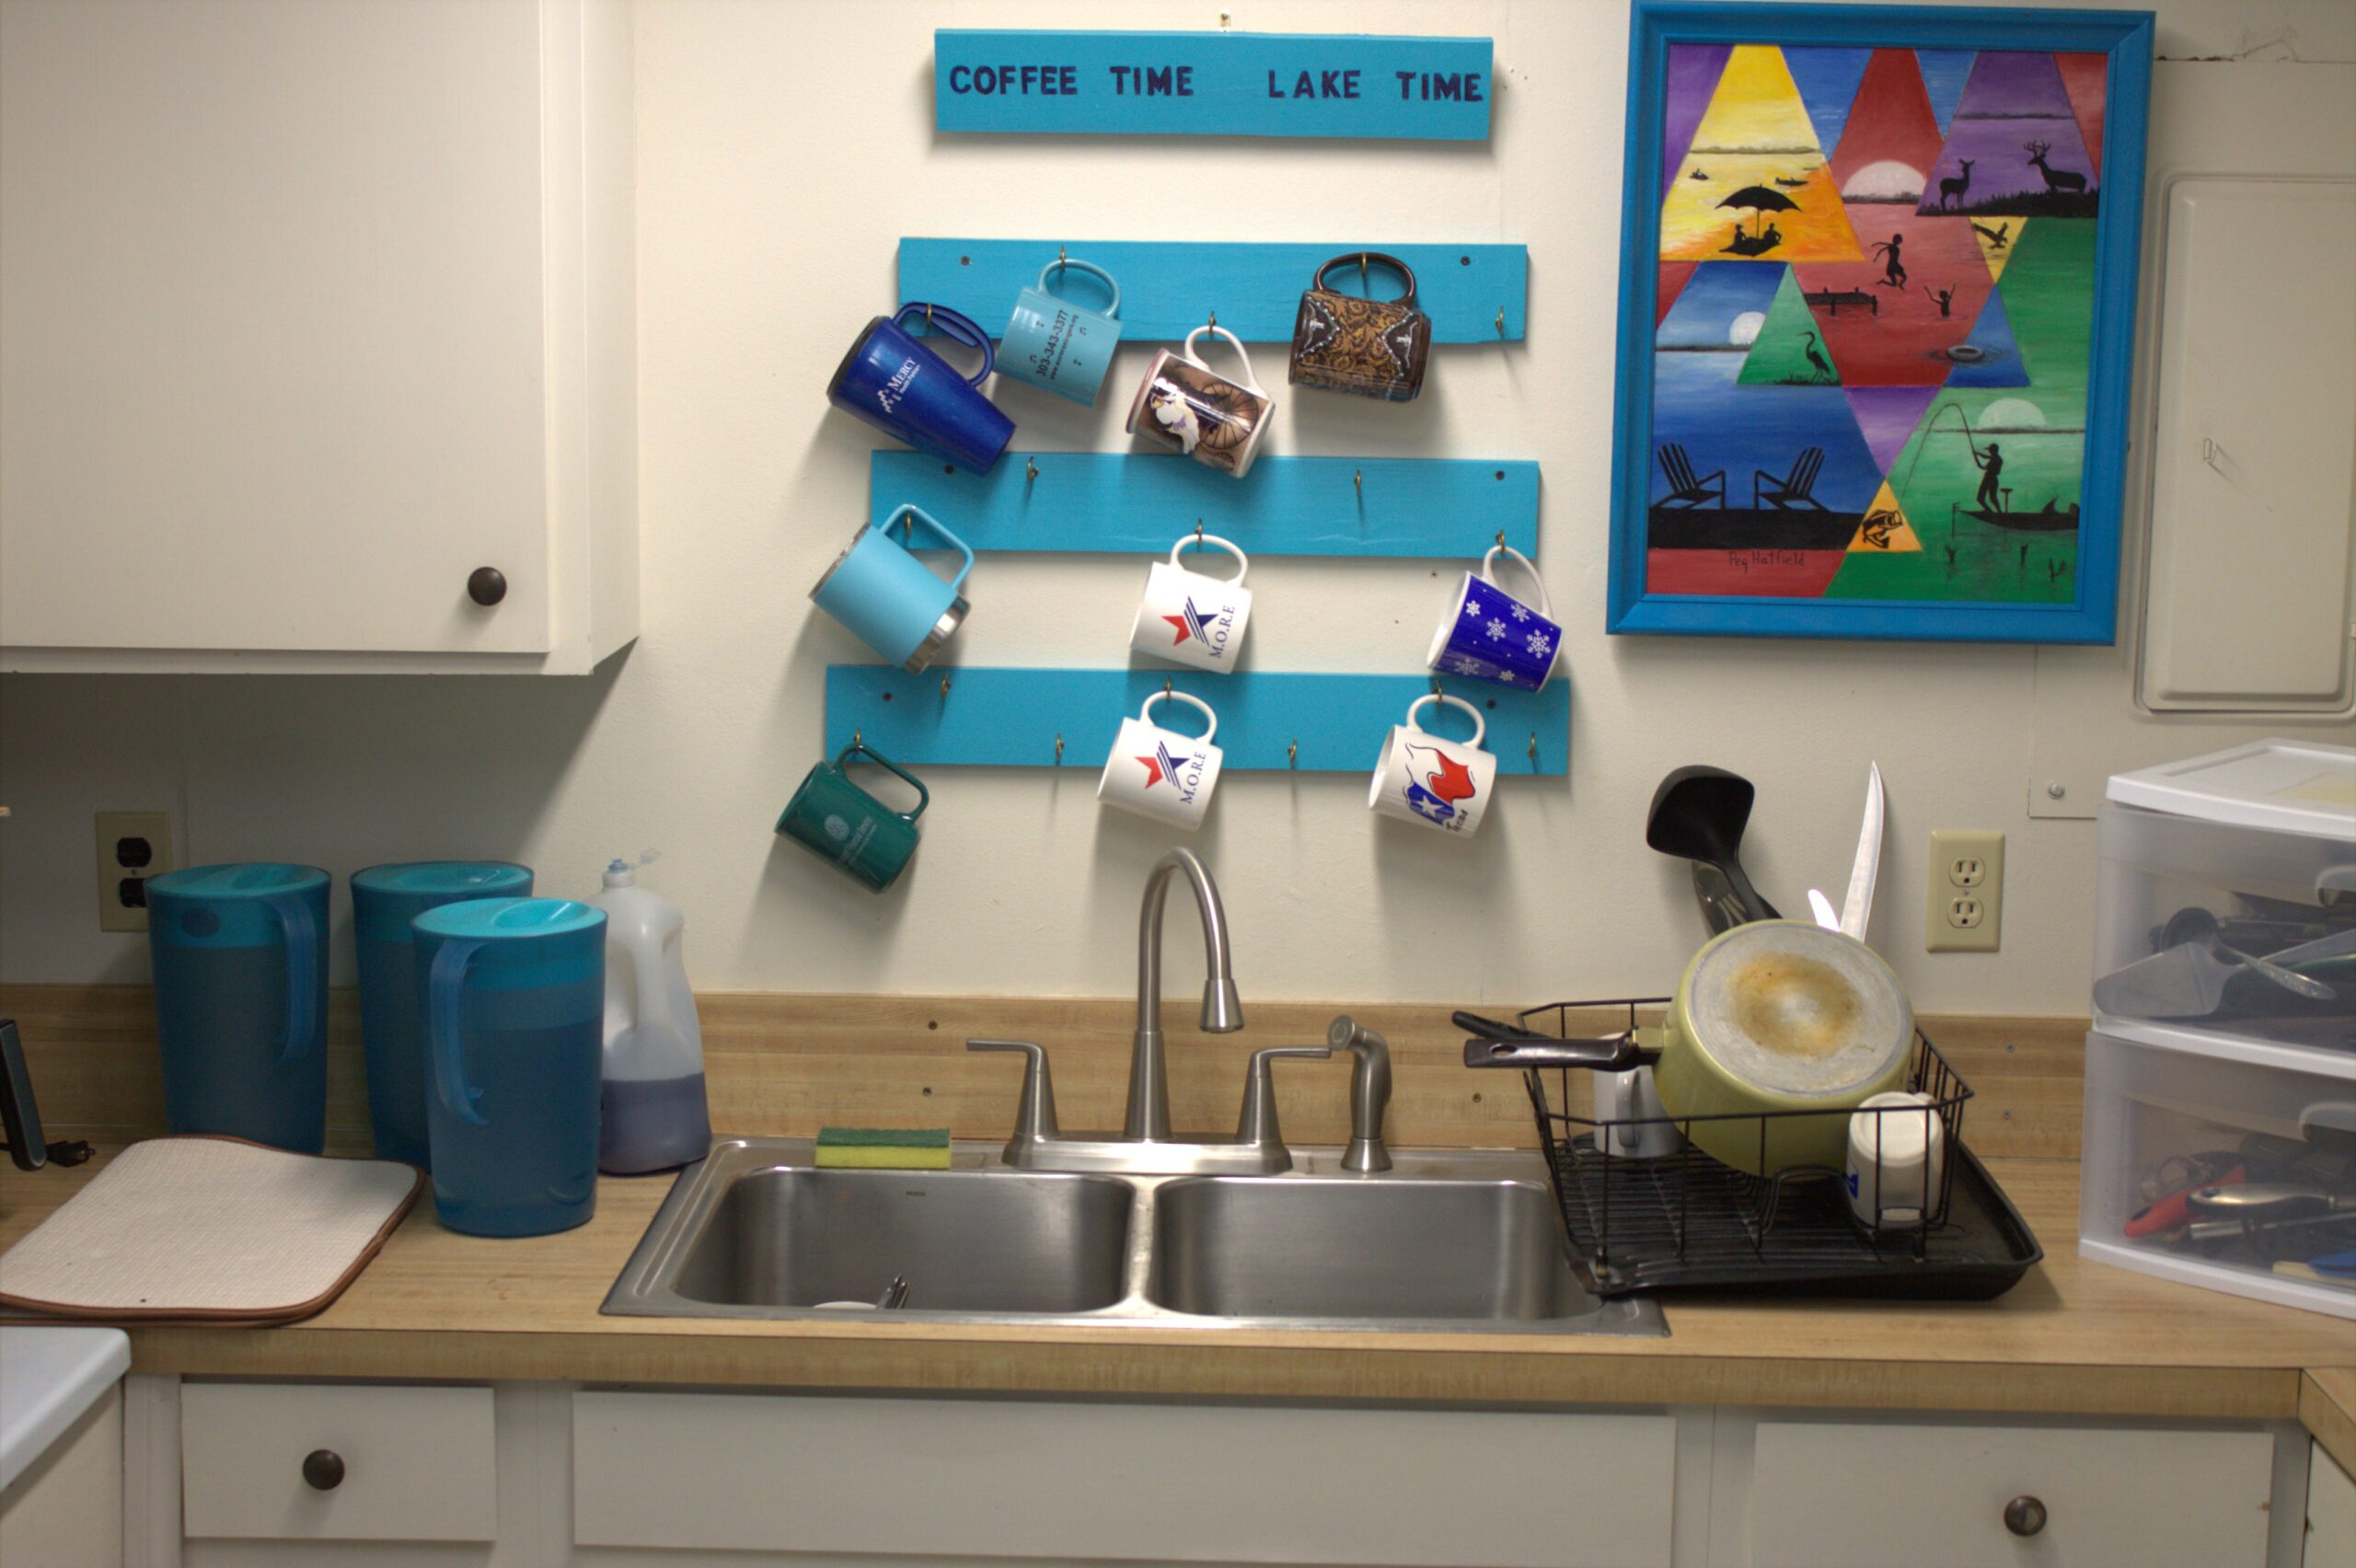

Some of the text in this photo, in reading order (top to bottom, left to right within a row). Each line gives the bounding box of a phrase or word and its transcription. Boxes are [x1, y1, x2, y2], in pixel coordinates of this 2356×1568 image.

[949, 65, 1484, 103] COFFEE TIME LAKE TIME
[1036, 309, 1068, 377] 303-343-3377
[887, 356, 916, 391] MERCY
[1728, 548, 1805, 574] Peg Hatfield
